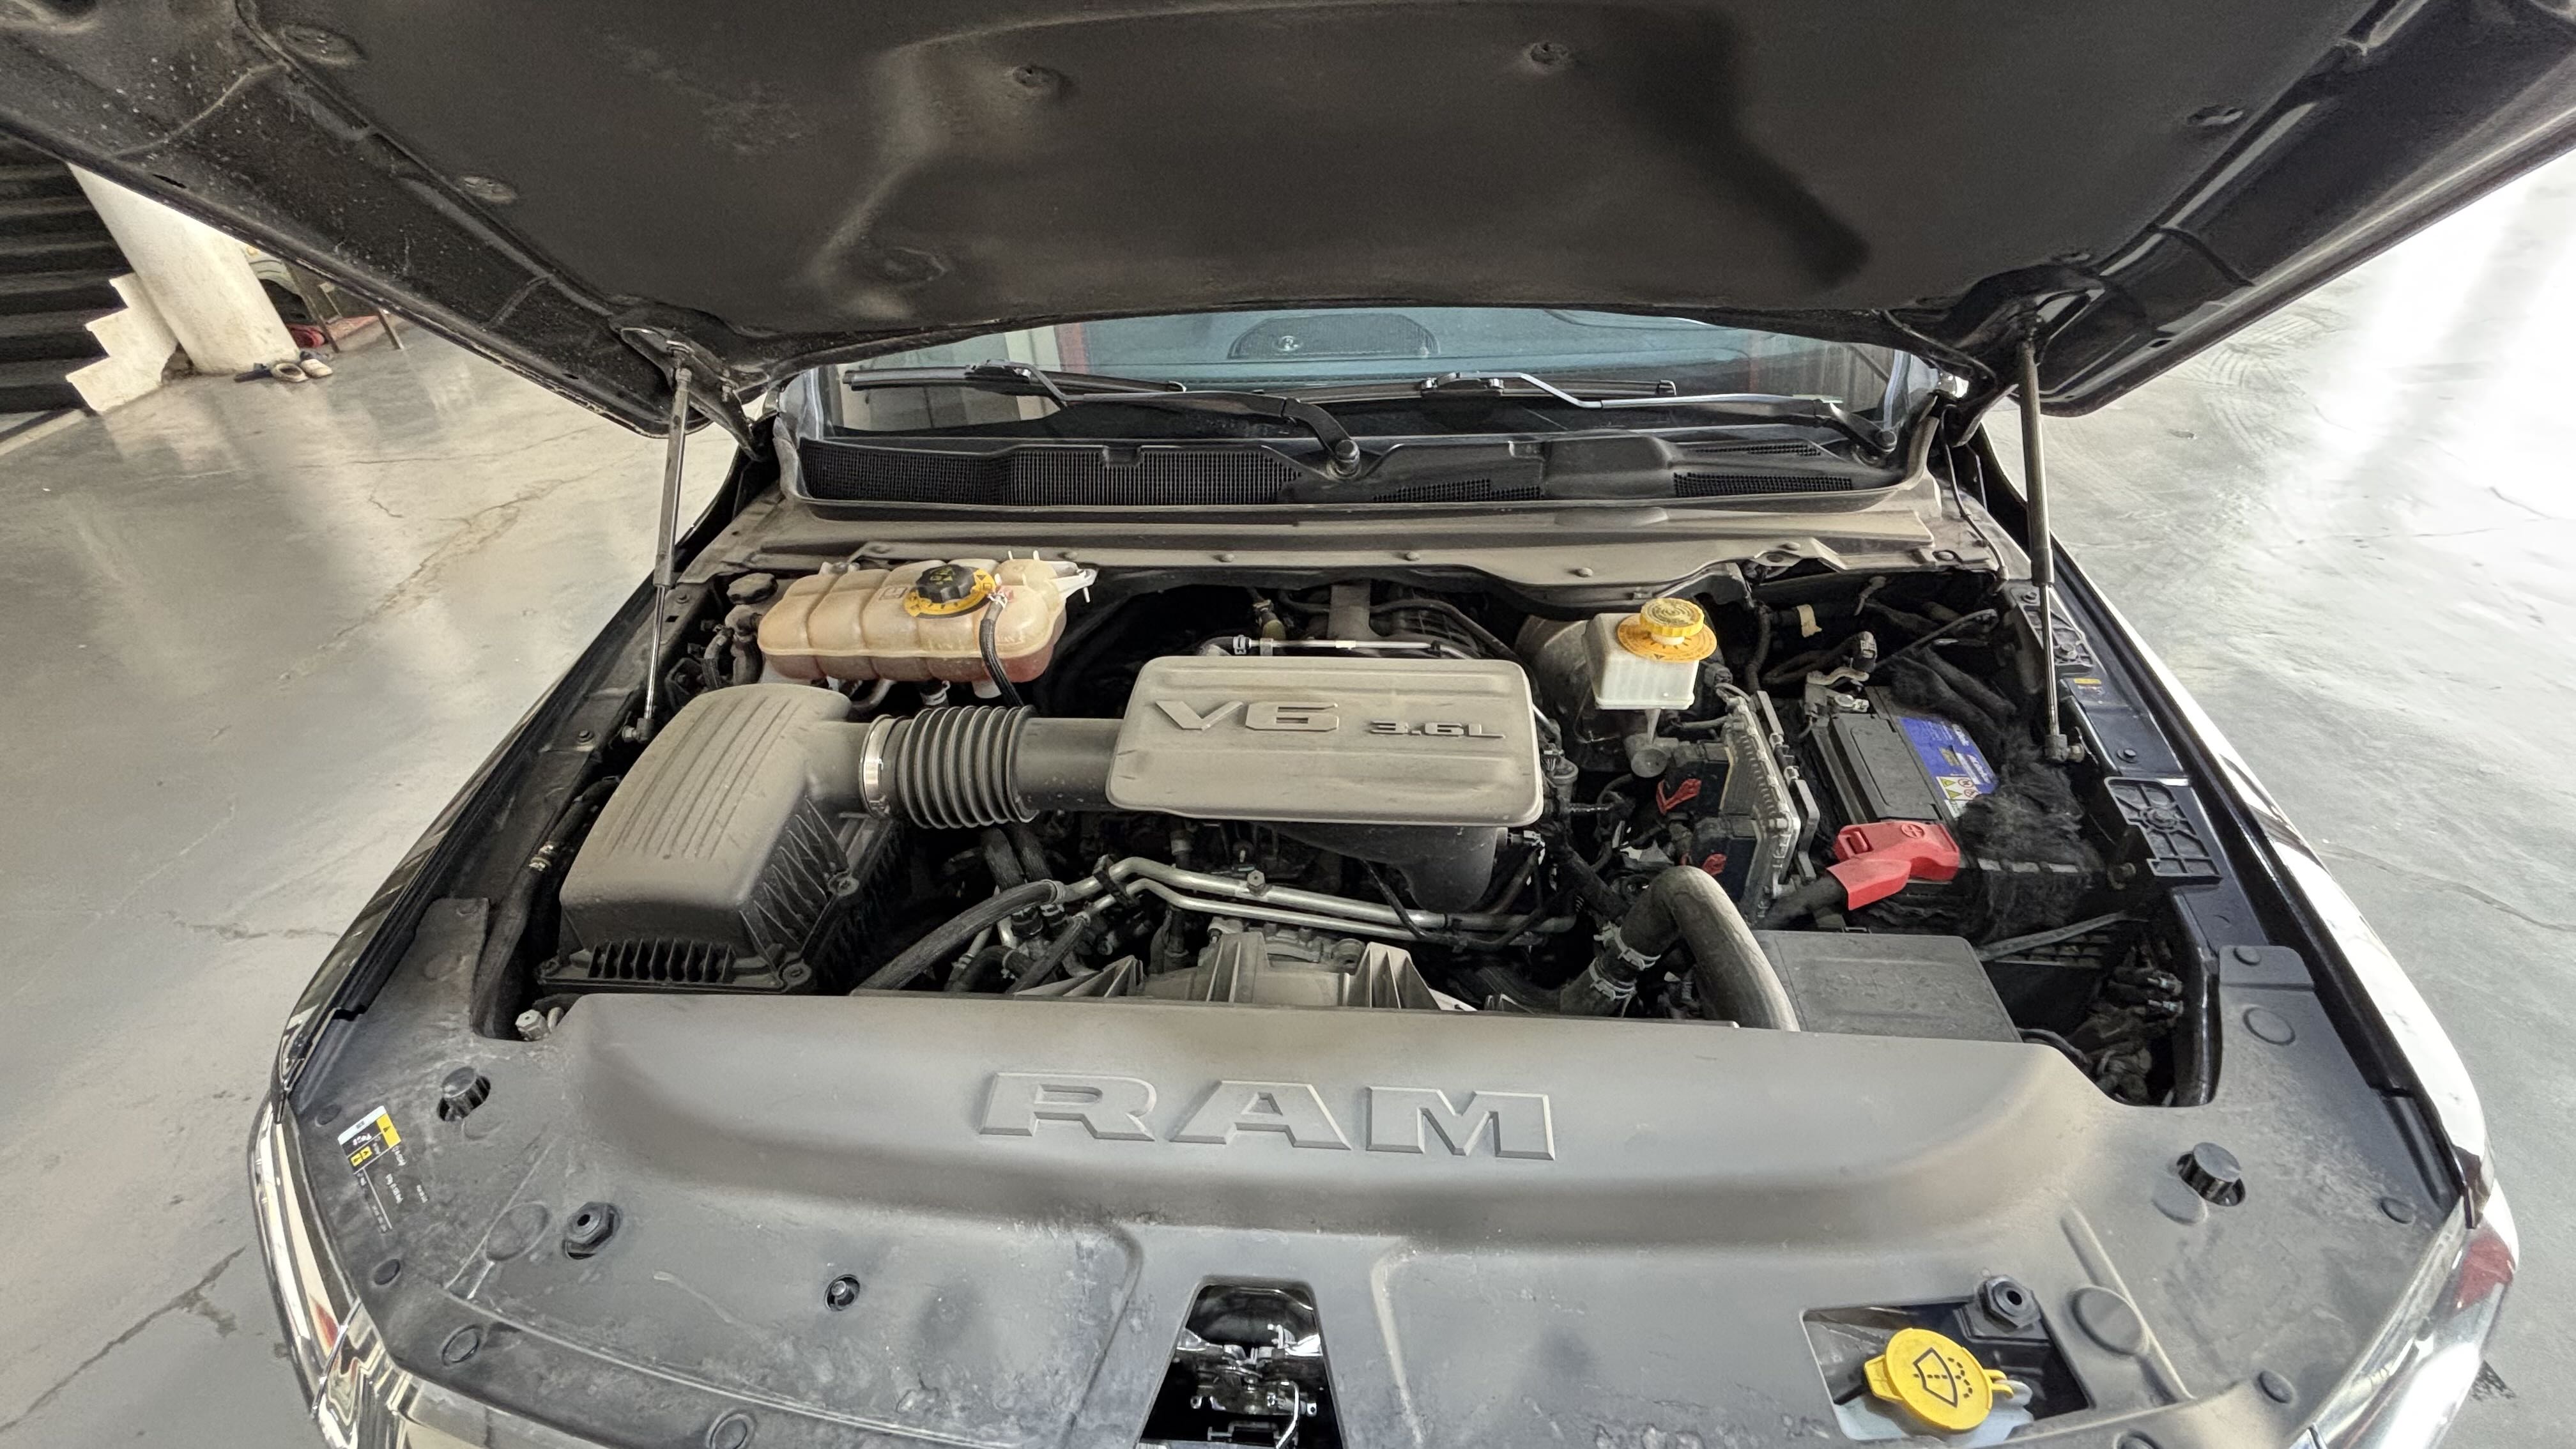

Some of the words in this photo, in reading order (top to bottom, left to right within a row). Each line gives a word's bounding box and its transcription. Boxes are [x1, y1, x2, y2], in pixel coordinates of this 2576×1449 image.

[1155, 701, 1340, 732] V6
[1368, 720, 1506, 739] 3.6L
[978, 1071, 1556, 1162] RAM
